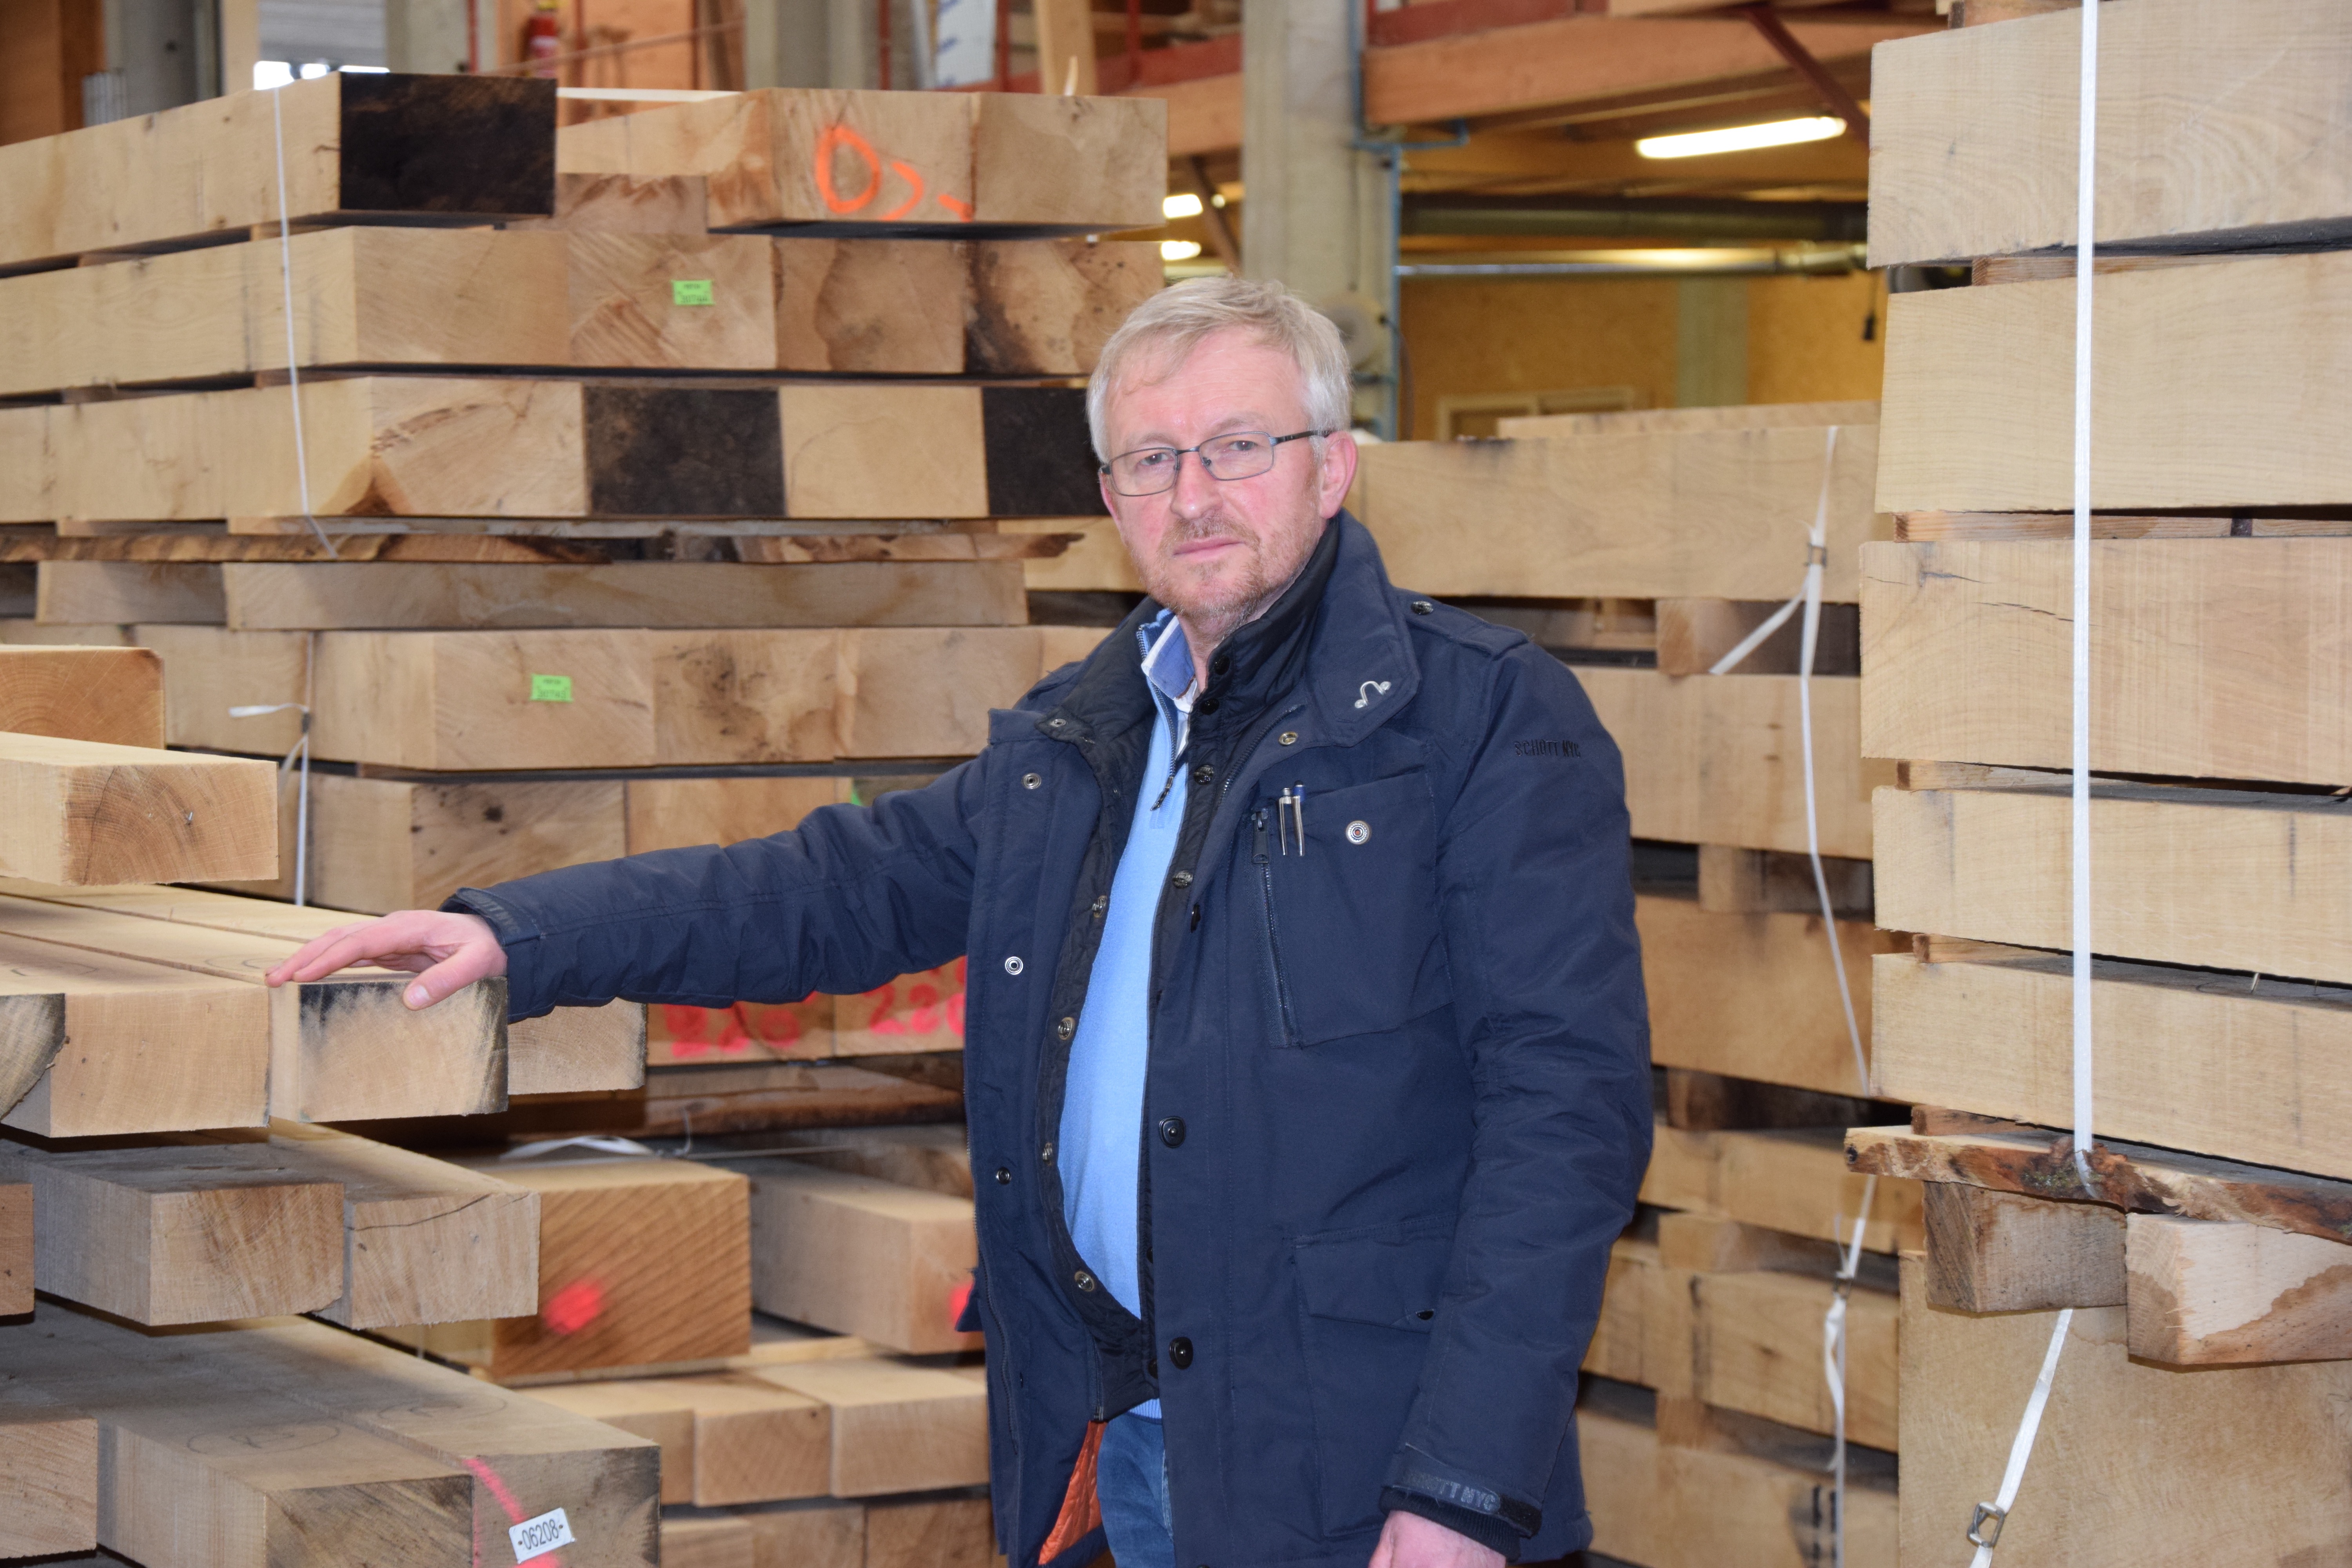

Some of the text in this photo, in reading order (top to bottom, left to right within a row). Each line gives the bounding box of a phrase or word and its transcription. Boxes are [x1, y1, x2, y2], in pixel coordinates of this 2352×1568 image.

[1514, 739, 1581, 758] SCHOTT NYC
[1461, 1486, 1496, 1511] NYC
[521, 1518, 559, 1550] 06208
